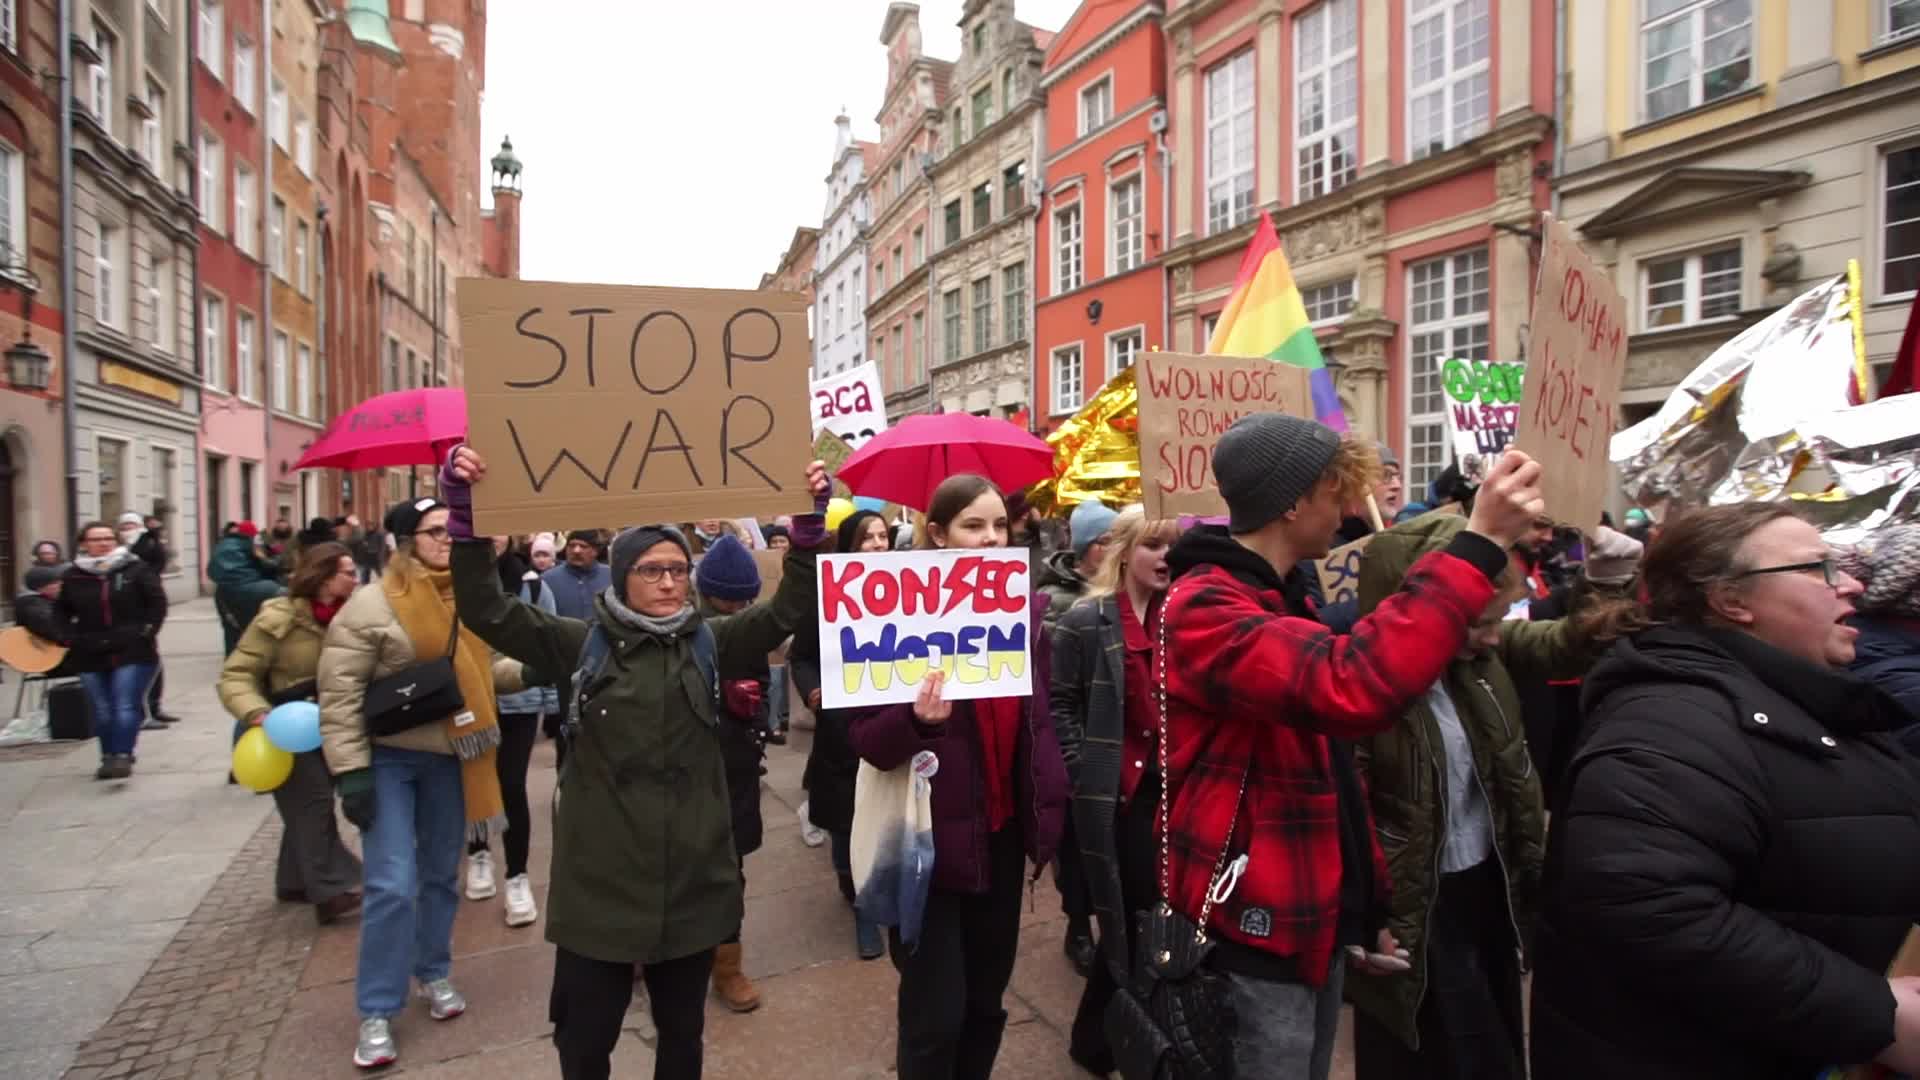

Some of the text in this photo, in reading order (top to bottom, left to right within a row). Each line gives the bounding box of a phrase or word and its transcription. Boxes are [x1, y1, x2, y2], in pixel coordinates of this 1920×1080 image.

[504, 307, 782, 395] STOP
[815, 381, 873, 418] aca
[506, 394, 783, 493] WAR
[840, 622, 1026, 695] WOJEN
